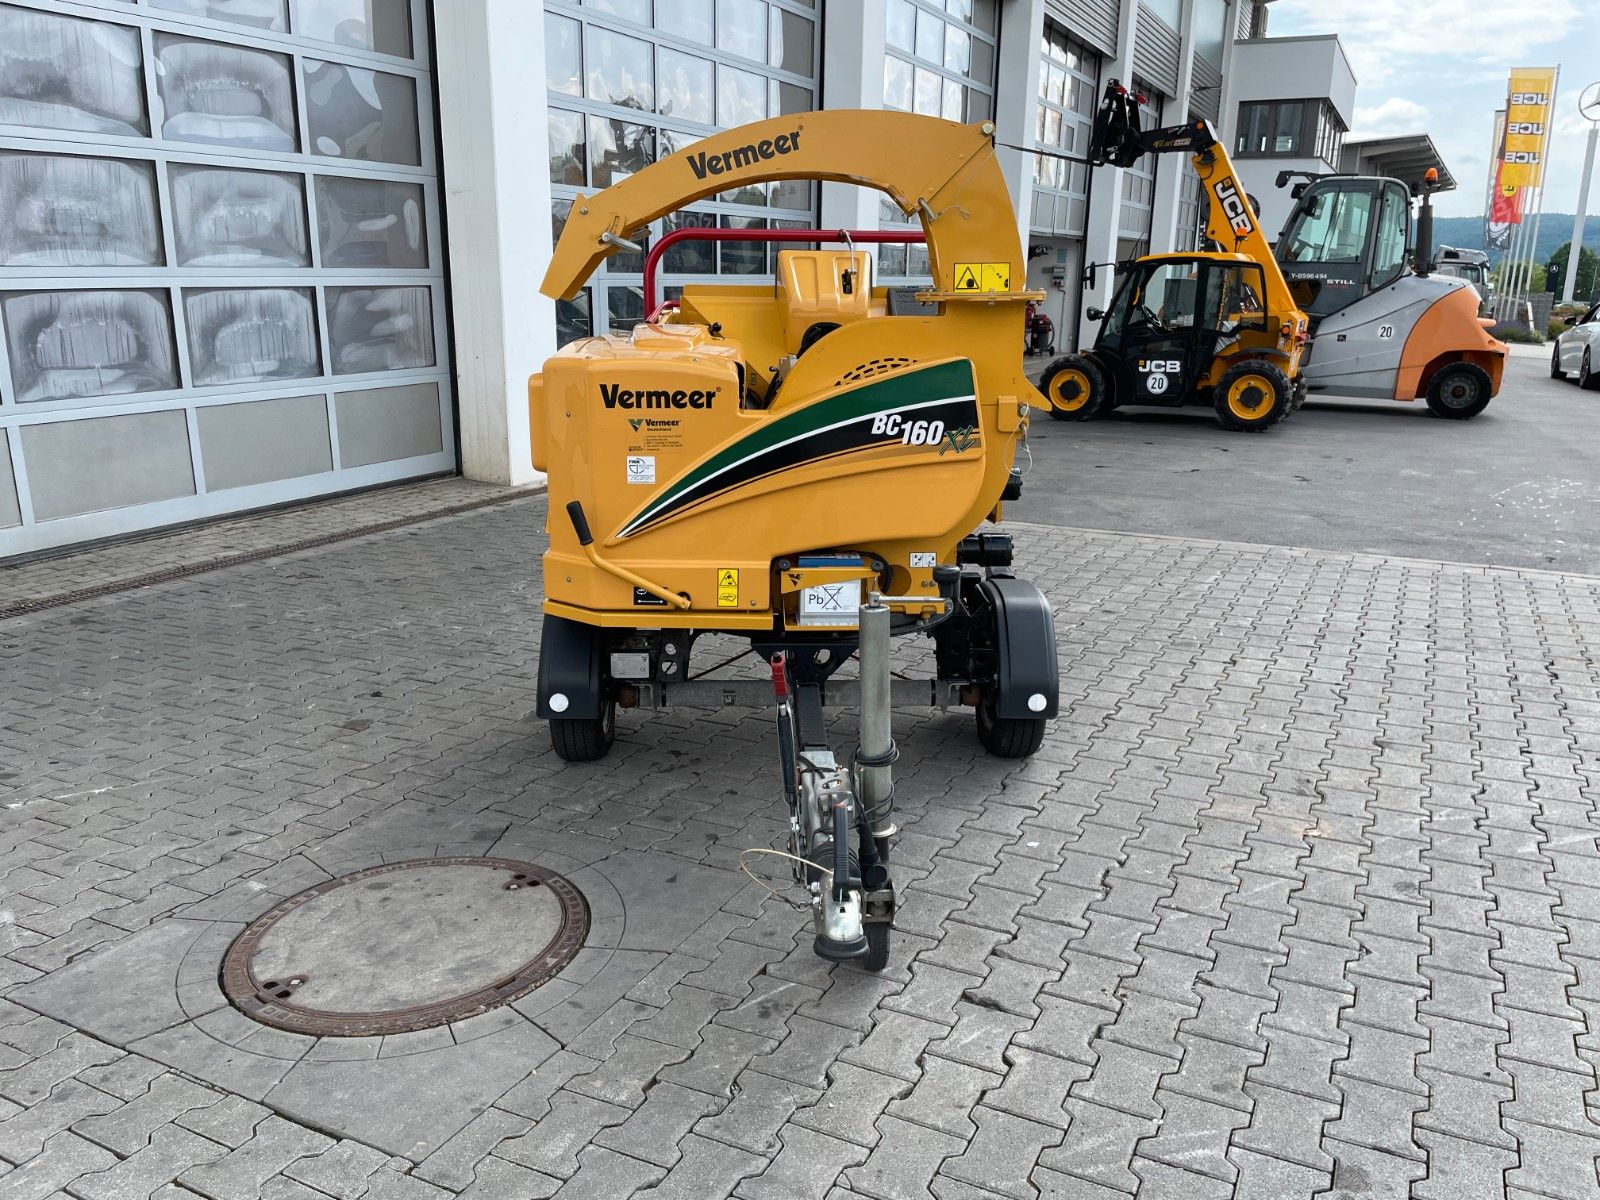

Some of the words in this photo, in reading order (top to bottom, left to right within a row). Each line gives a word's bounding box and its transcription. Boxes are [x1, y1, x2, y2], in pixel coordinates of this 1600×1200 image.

[686, 130, 800, 179] Vermeer
[1215, 180, 1252, 234] JCB
[1380, 326, 1392, 338] 20
[1138, 360, 1181, 372] JCB
[1150, 377, 1164, 390] 20
[598, 383, 716, 409] Vermeer
[644, 418, 680, 427] Vermeer
[871, 414, 902, 436] BC
[901, 420, 945, 446] 160
[938, 424, 977, 457] XL
[808, 593, 824, 605] Pb
